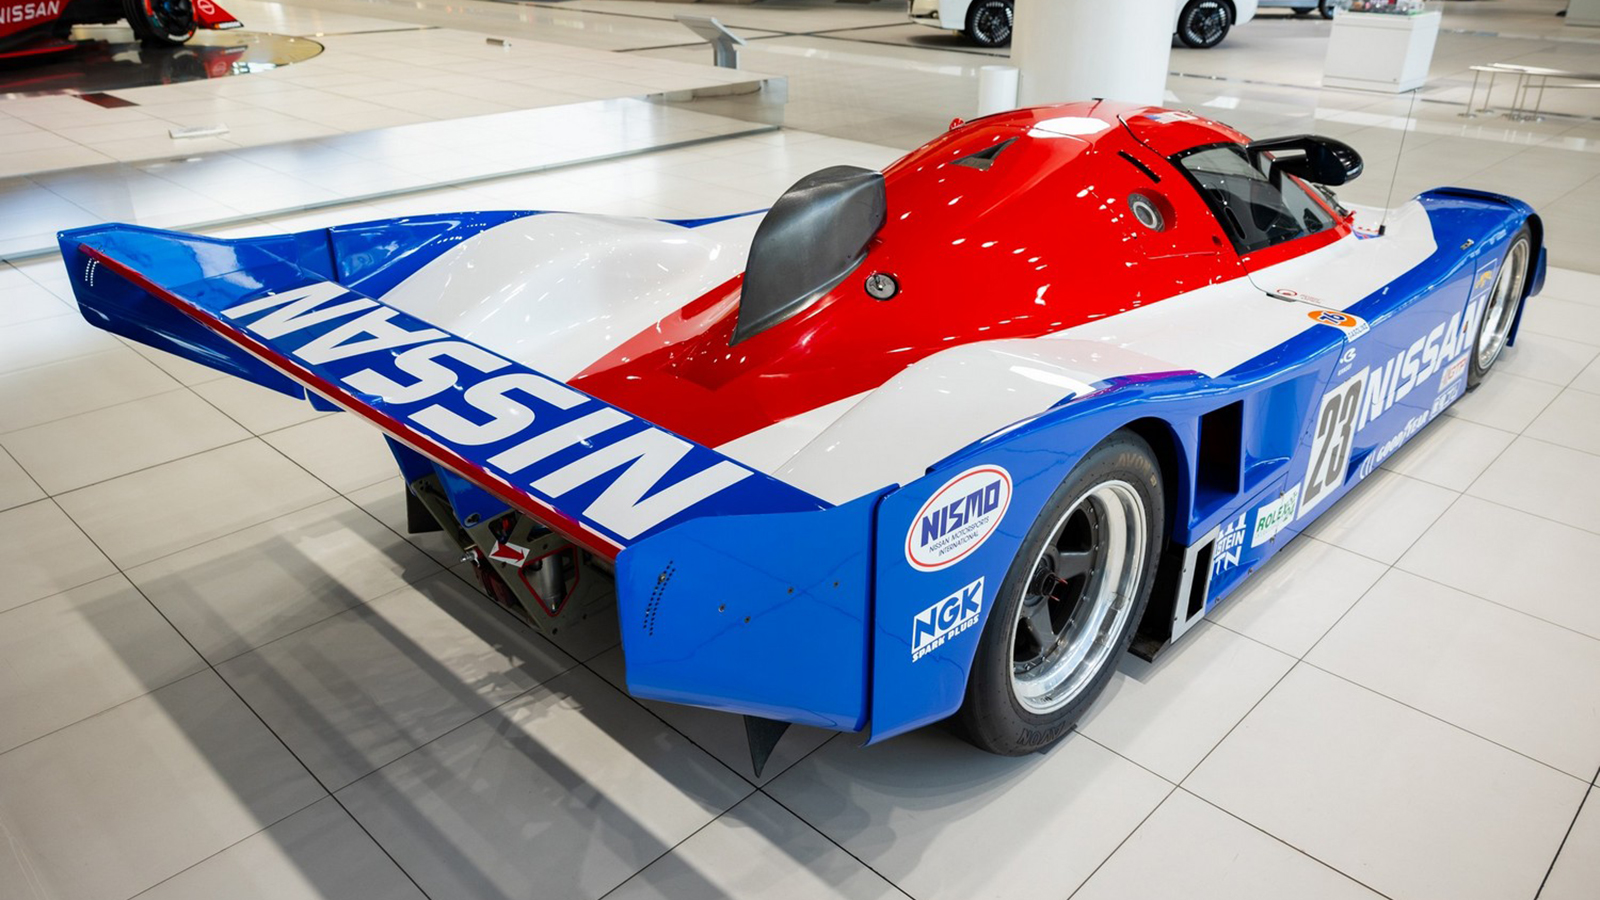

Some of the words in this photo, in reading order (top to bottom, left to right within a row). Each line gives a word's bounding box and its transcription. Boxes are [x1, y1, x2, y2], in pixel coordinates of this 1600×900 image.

[1318, 311, 1346, 325] 76
[1356, 294, 1486, 433] NISSAN
[220, 280, 755, 541] NISSAN
[1302, 379, 1362, 506] 23
[1115, 452, 1151, 478] AVON
[920, 479, 1001, 548] NISMO
[928, 536, 951, 553] NISSAN
[950, 515, 990, 541] MOTORSPORTS
[938, 530, 979, 557] INTERNATIONAL
[1214, 529, 1246, 556] STEIN
[913, 580, 983, 651] NGK
[911, 635, 946, 663] SPARK
[947, 613, 980, 641] PLUGS
[1016, 720, 1067, 747] AVON
